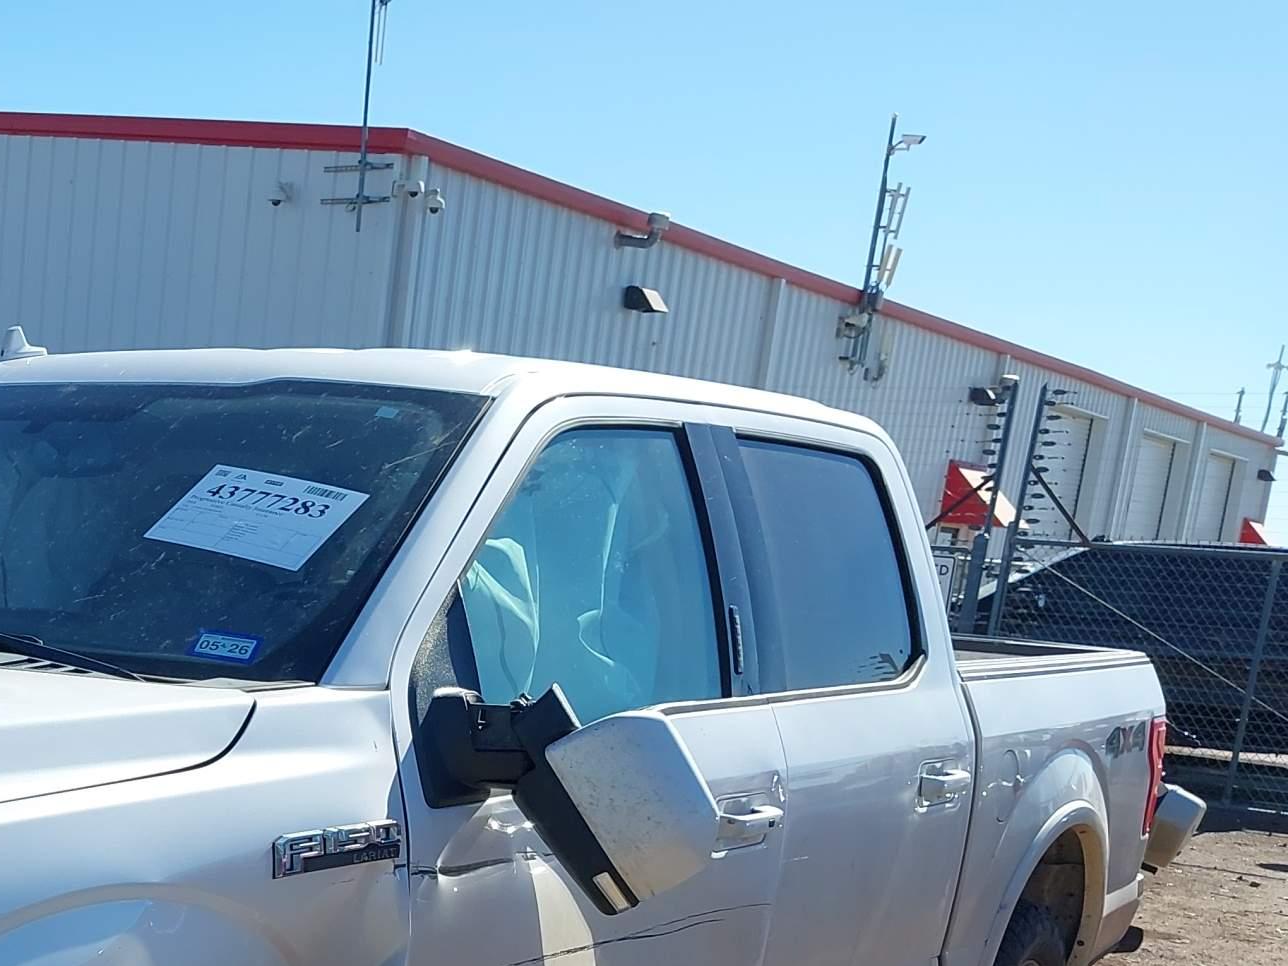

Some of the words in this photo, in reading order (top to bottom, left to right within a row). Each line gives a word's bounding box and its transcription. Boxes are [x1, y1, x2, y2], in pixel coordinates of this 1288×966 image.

[207, 484, 330, 519] 43777283
[199, 640, 221, 651] 05
[228, 643, 250, 655] 26
[353, 848, 397, 864] LARIAT
